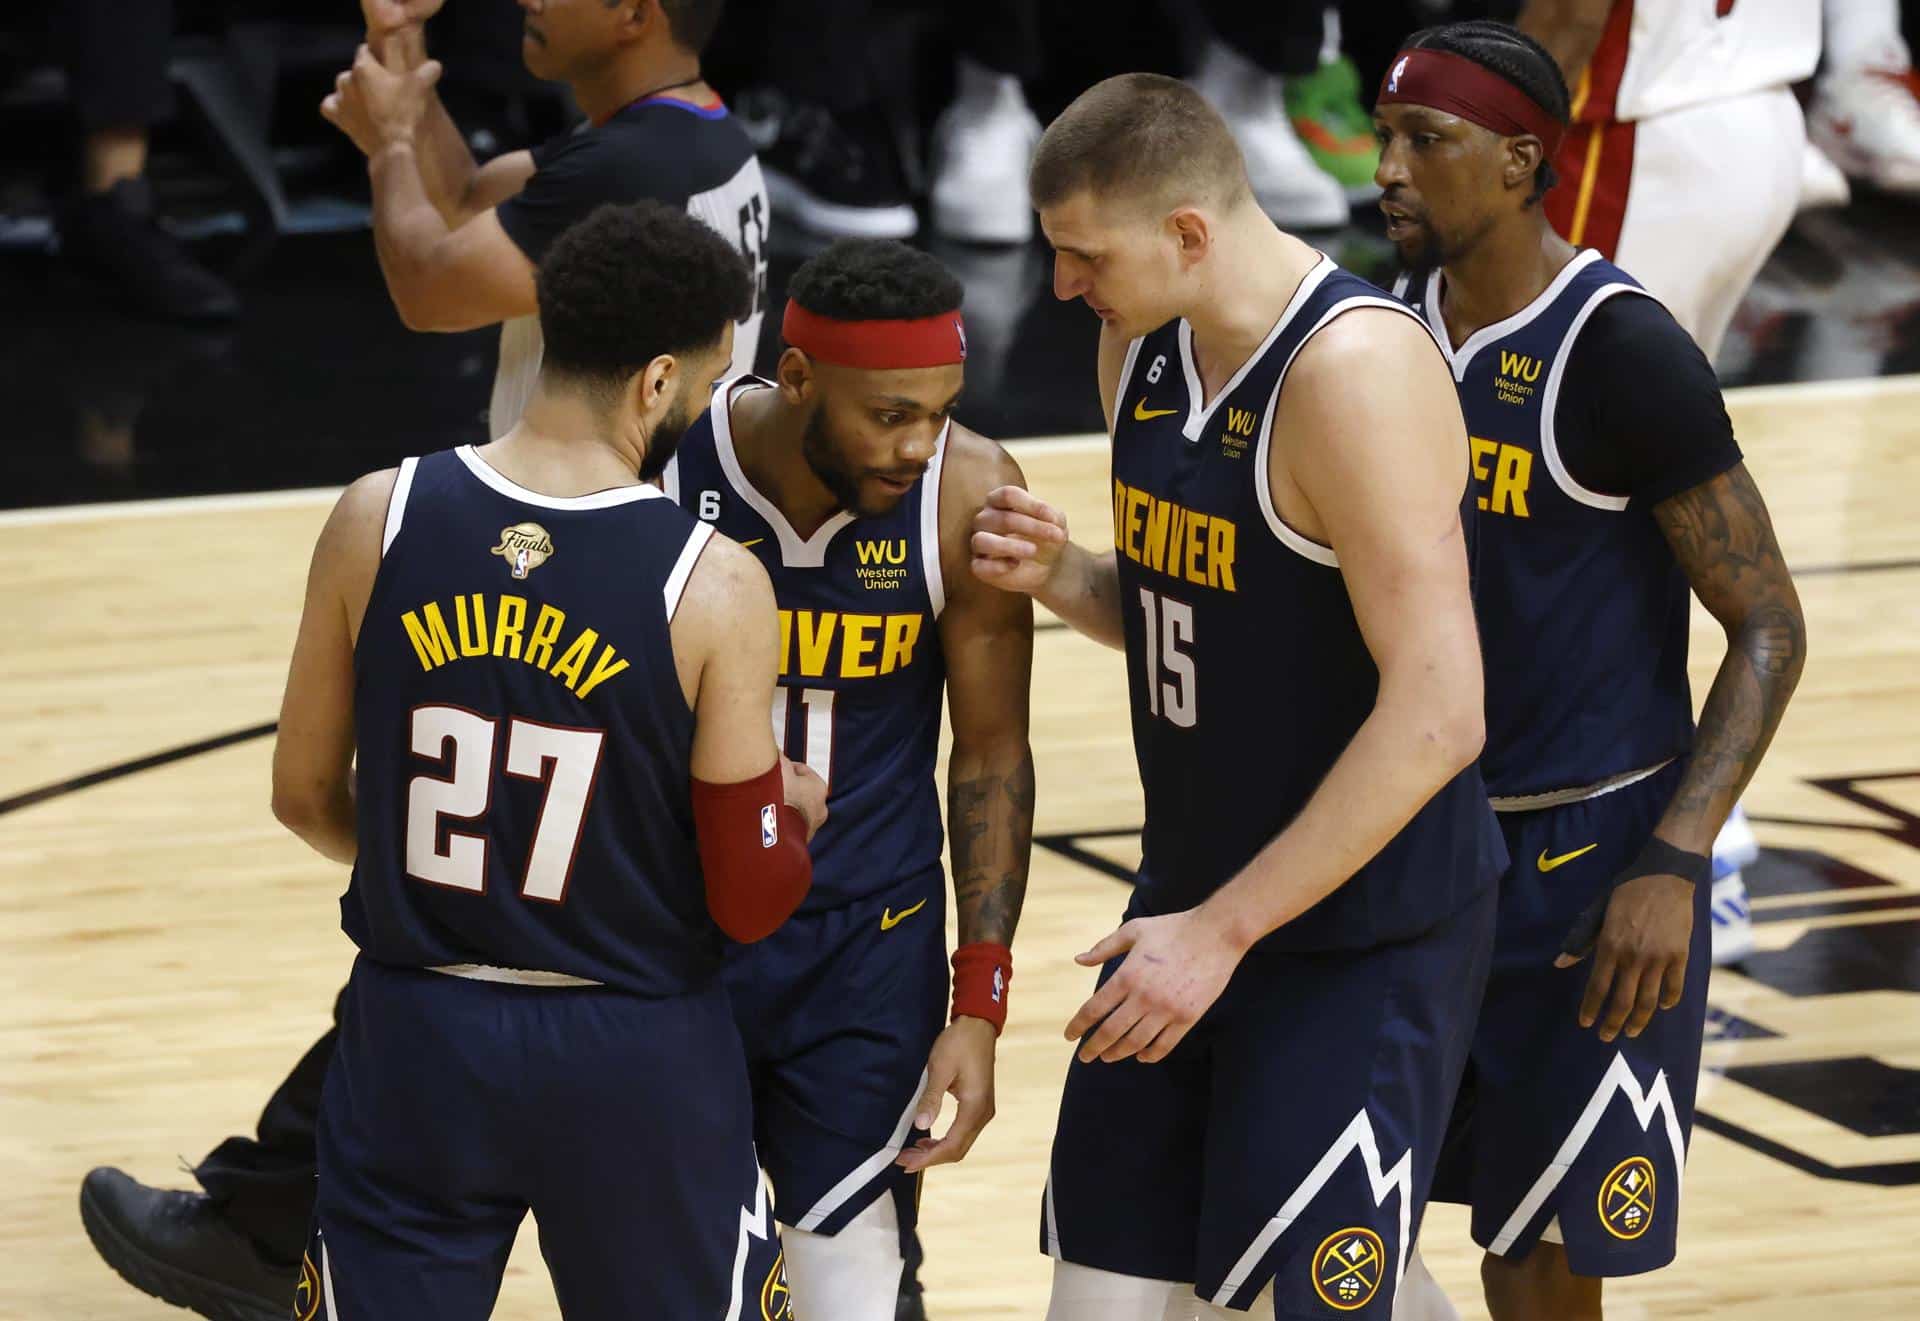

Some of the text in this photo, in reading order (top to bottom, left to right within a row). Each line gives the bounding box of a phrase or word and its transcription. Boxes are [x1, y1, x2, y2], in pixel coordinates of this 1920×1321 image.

[1146, 354, 1167, 384] 6
[1501, 350, 1542, 382] WU
[1494, 377, 1534, 396] Western
[1498, 390, 1525, 405] Union
[1228, 407, 1256, 436] WU
[700, 490, 721, 521] 6
[496, 529, 551, 553] Finals
[1115, 478, 1236, 592] DENVER
[856, 539, 907, 565] WU
[856, 567, 907, 578] Western
[865, 578, 900, 590] Union
[400, 592, 630, 700] MURRAY
[1139, 587, 1197, 728] 15
[405, 703, 605, 904] 27
